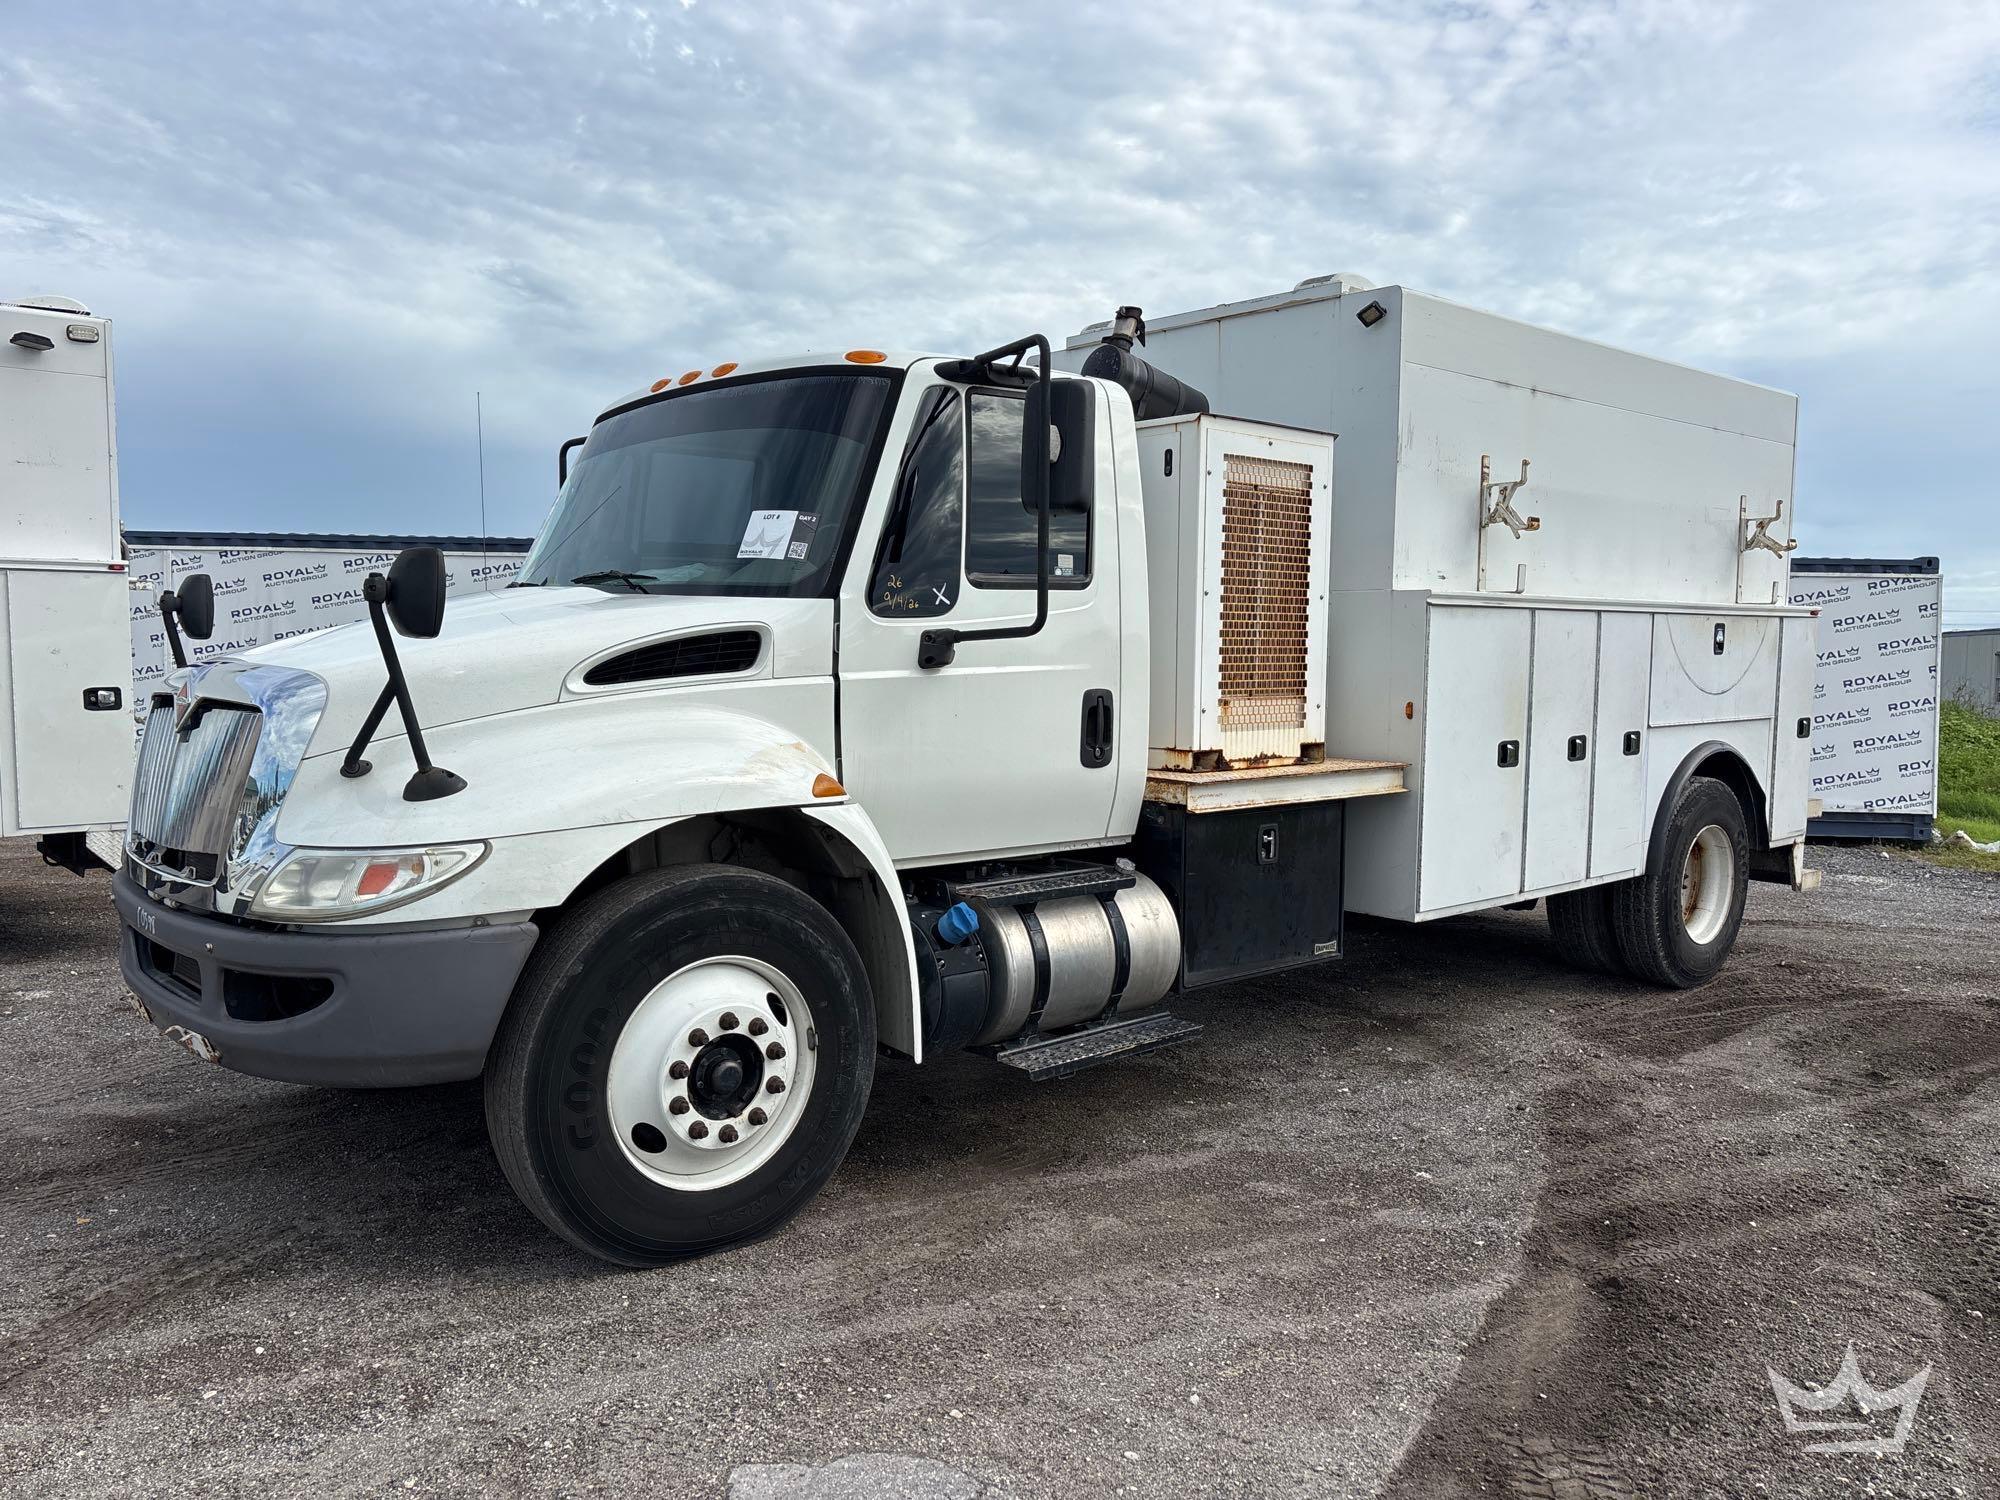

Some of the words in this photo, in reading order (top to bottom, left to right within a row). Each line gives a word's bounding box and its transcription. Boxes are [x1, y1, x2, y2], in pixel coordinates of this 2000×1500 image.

[221, 555, 256, 565] AUCTION
[343, 554, 394, 569] ROYAL
[175, 563, 204, 573] GROUP
[262, 567, 314, 582] ROYAL
[345, 564, 380, 574] AUCTION
[470, 562, 521, 577] ROYAL
[264, 578, 300, 589] AUCTION
[300, 573, 329, 582] GROUP
[472, 572, 508, 583] AUCTION
[887, 574, 903, 588] 26
[219, 587, 248, 596] GROUP
[1869, 586, 1907, 597] AUCTION
[1907, 580, 1937, 590] GROUP
[311, 589, 362, 605] ROYAL
[1821, 595, 1851, 605] GROUP
[231, 603, 282, 618] ROYAL
[313, 600, 349, 610] AUCTION
[139, 612, 161, 620] GROU
[233, 614, 269, 625] AUCTION
[269, 609, 297, 618] GROUP
[1832, 611, 1887, 628] ROYAL
[1834, 623, 1872, 634] AUCTION
[1872, 618, 1902, 628] GROUP
[193, 640, 245, 655] ROYAL
[1877, 635, 1932, 651] ROYAL
[1880, 647, 1917, 657] AUCTION
[1917, 643, 1937, 651] GRO
[1816, 647, 1846, 661] YAL
[1832, 655, 1861, 666] GROUP
[132, 664, 164, 676] YAL
[1842, 672, 1897, 688] ROYAL
[1845, 683, 1882, 694] AUCTION
[1882, 678, 1912, 688] GROUP
[1814, 710, 1857, 724] OYAL
[1890, 707, 1927, 718] AUCTION
[1842, 716, 1872, 726] GROUP
[1853, 733, 1908, 748] ROYAL
[1855, 744, 1892, 755] AUCTION
[1892, 739, 1922, 749] GROUP
[1898, 759, 1934, 772] ROY
[1812, 770, 1867, 786] ROYAL
[1814, 781, 1852, 792] AUCTION
[1852, 776, 1882, 786] GROUP
[1863, 793, 1918, 809] ROYAL
